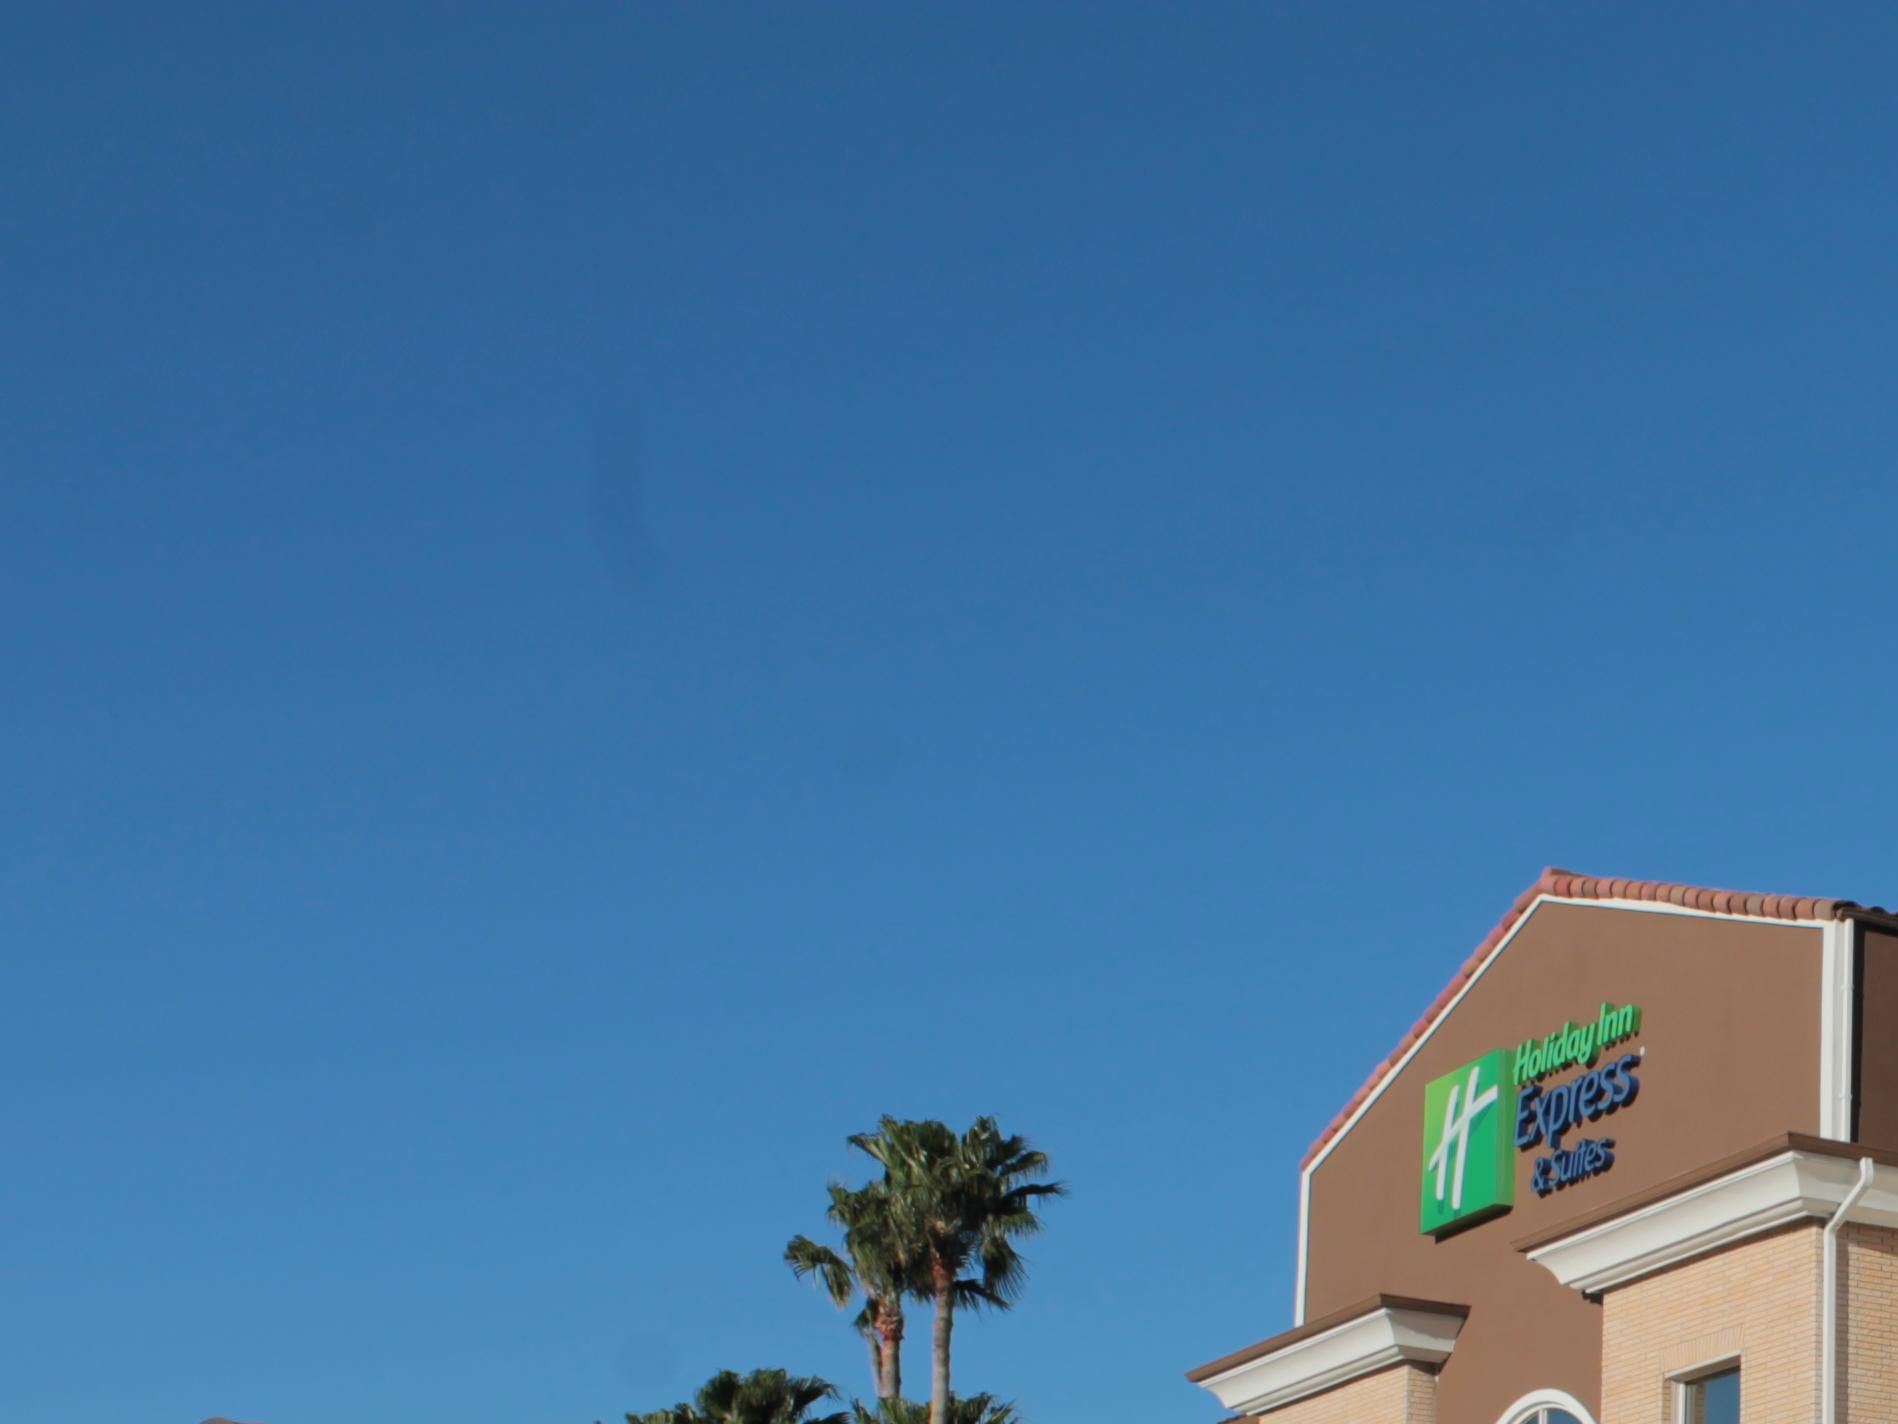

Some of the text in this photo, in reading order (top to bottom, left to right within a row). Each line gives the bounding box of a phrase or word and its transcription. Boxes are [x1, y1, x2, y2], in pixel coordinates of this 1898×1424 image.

[1513, 1002, 1640, 1086] Holiday Inn
[1513, 1053, 1640, 1150] Express
[1530, 1138, 1613, 1194] & Suites
